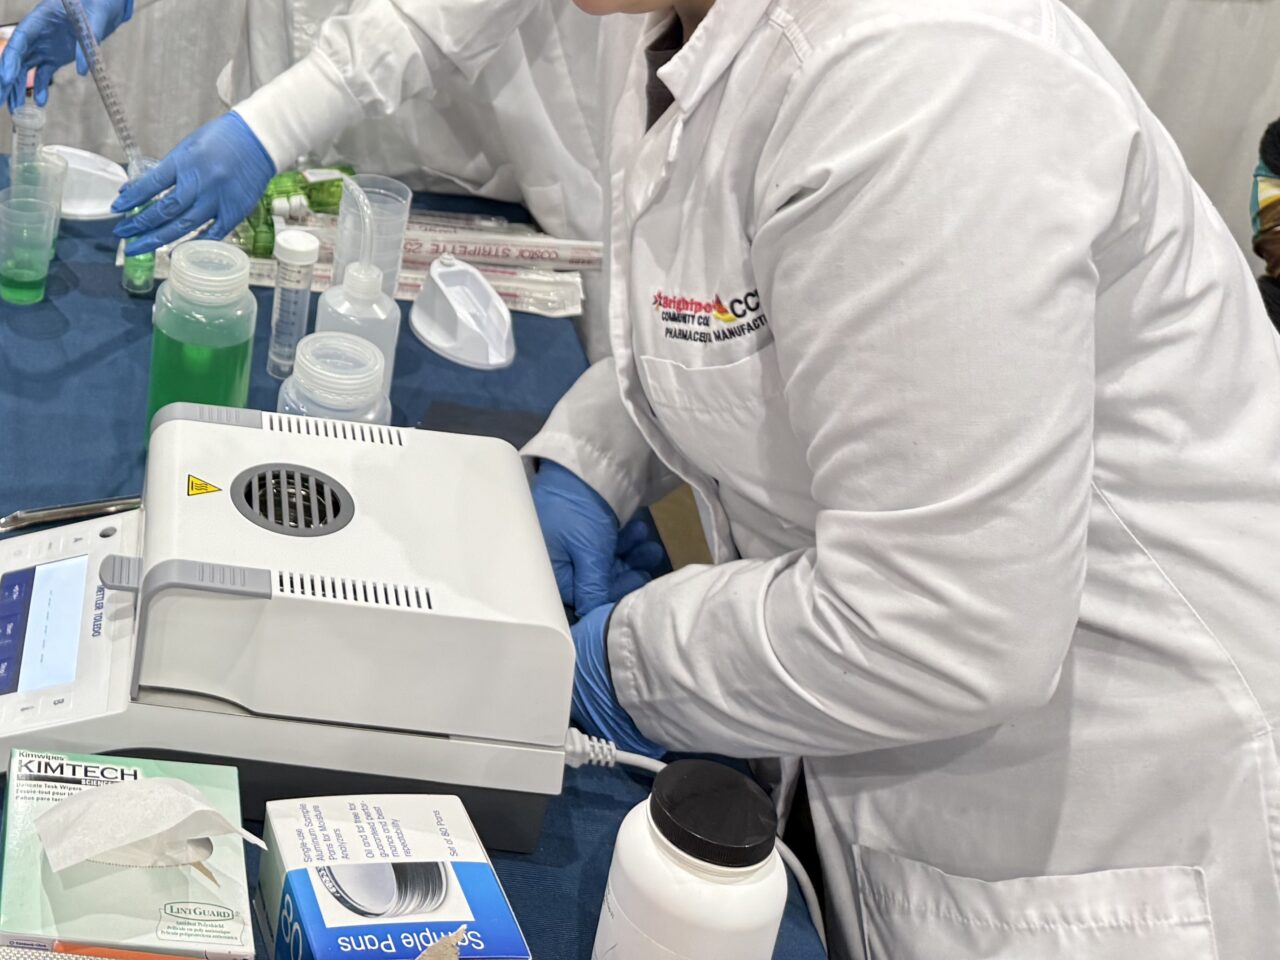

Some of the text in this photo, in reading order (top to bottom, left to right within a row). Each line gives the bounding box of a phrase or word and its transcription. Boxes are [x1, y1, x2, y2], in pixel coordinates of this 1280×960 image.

[431, 243, 511, 258] STRIPETTE
[91, 585, 105, 637] METTLER TOLEDO
[20, 751, 65, 761] Kimwipes
[20, 760, 138, 780] KIMTECH
[312, 805, 327, 831] Moisture
[432, 809, 445, 826] Pans
[300, 804, 325, 861] Aluminum Sample
[322, 833, 331, 842] for
[360, 834, 371, 847] and
[366, 821, 390, 858] guaranteed
[373, 806, 400, 857] mance and best
[391, 819, 412, 857] repeatability
[443, 837, 454, 845] of
[296, 828, 313, 863] Single-use
[326, 843, 338, 860] Pans
[333, 828, 350, 860] Analyzers
[364, 849, 375, 858] Oil
[337, 933, 397, 953] Pans
